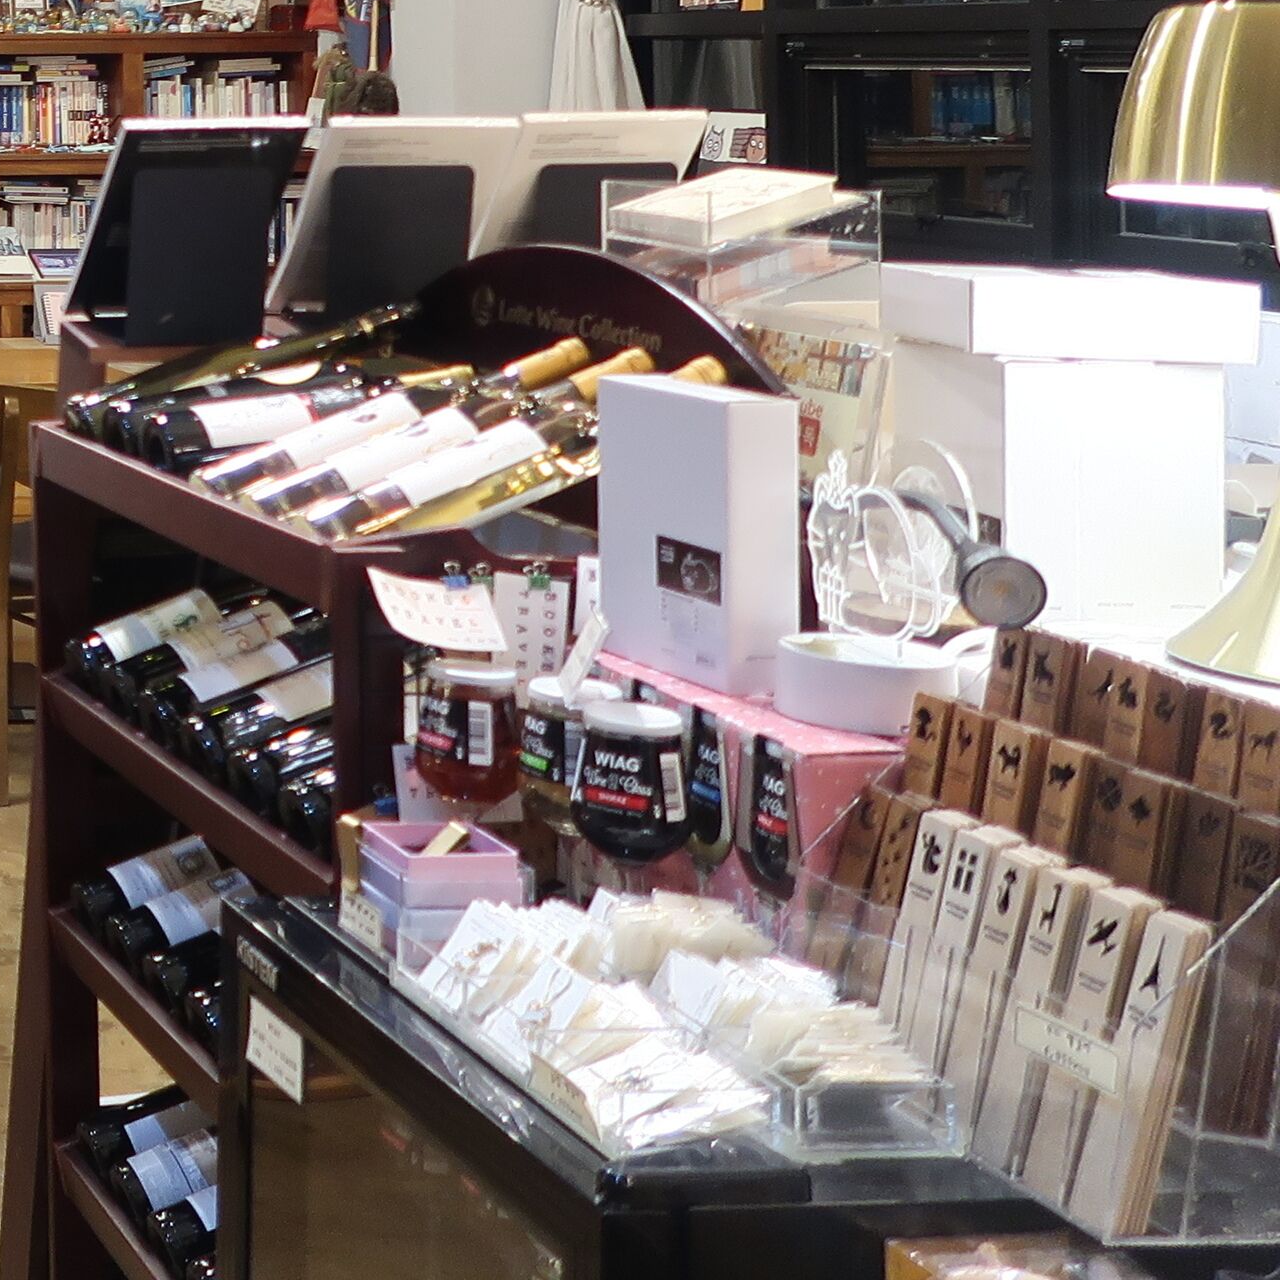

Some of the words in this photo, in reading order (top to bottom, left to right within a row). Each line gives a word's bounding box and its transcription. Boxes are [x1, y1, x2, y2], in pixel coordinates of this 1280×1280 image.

[535, 305, 577, 334] Wine
[578, 313, 664, 352] Collection
[594, 749, 641, 773] WIAG
